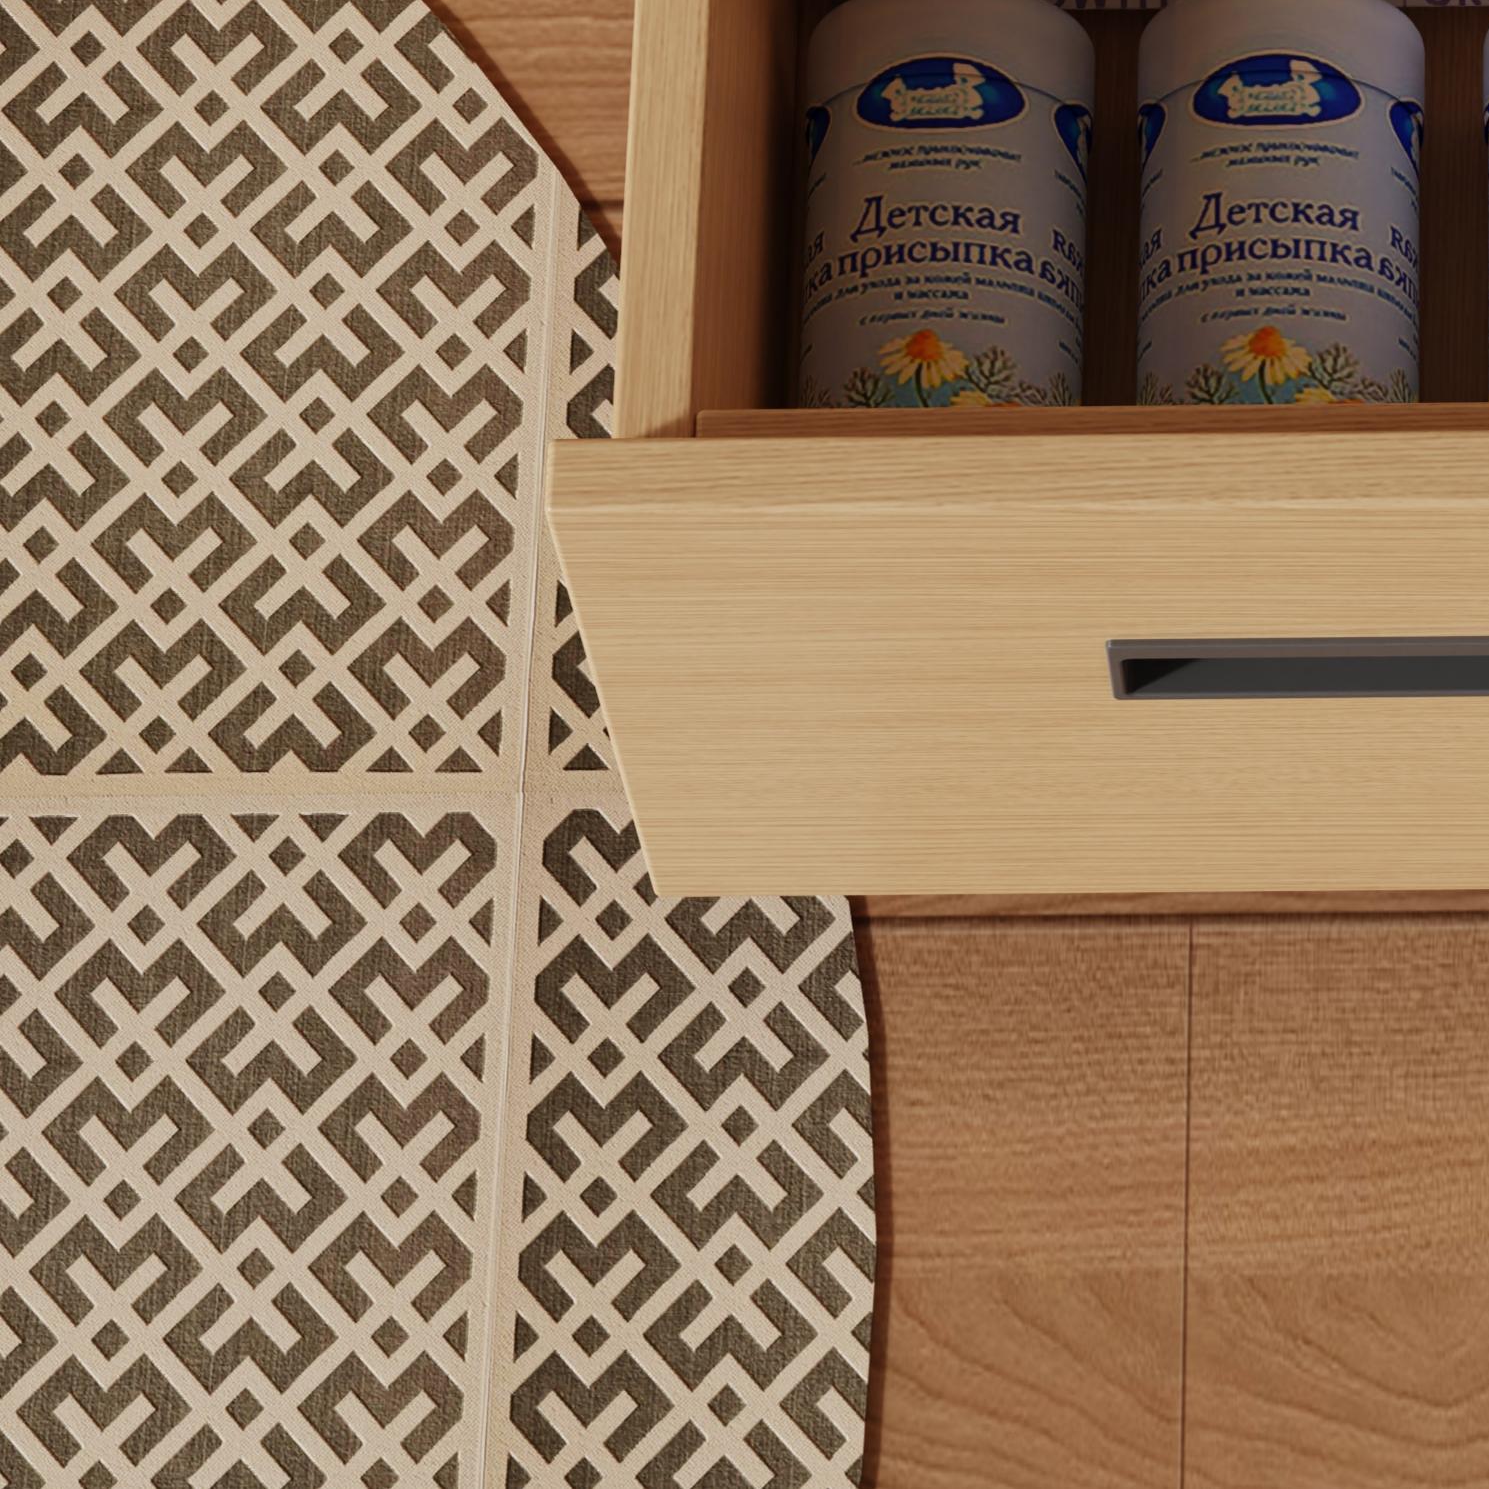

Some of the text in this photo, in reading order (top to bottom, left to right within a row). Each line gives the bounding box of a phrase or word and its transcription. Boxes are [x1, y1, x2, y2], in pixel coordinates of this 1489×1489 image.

[850, 195, 1021, 243] Детская
[1189, 192, 1360, 239] Детская
[838, 240, 1034, 278] присыпка
[1178, 236, 1376, 275] присыпка
